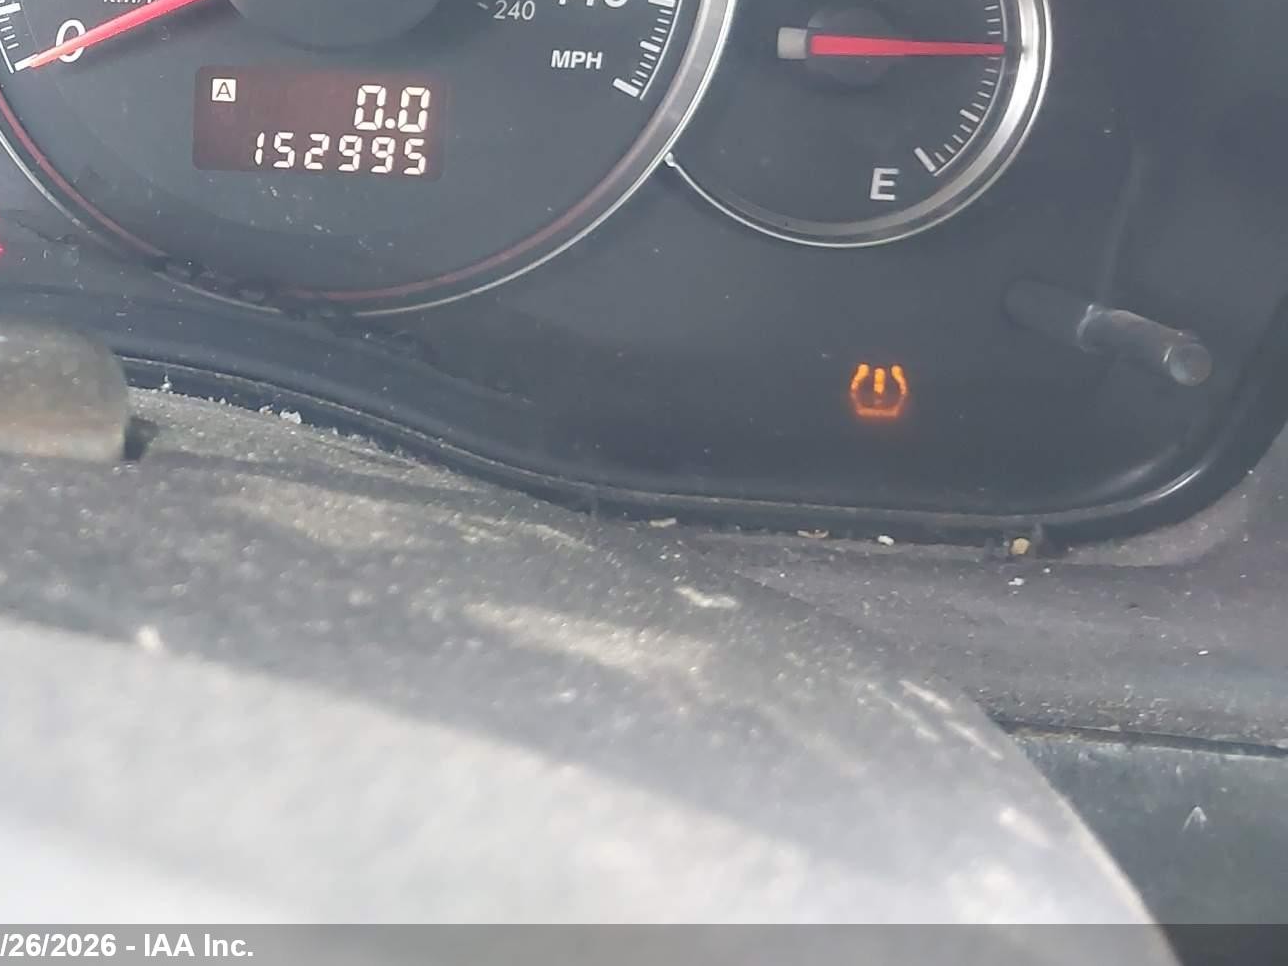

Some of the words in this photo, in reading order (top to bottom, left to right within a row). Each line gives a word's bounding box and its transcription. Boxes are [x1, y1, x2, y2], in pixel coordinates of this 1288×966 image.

[493, 0, 536, 21] 240
[55, 19, 87, 63] 0
[550, 49, 603, 70] MPH
[213, 80, 235, 101] A
[353, 84, 431, 133] 0.0
[254, 131, 427, 175] 152995
[870, 167, 899, 201] E
